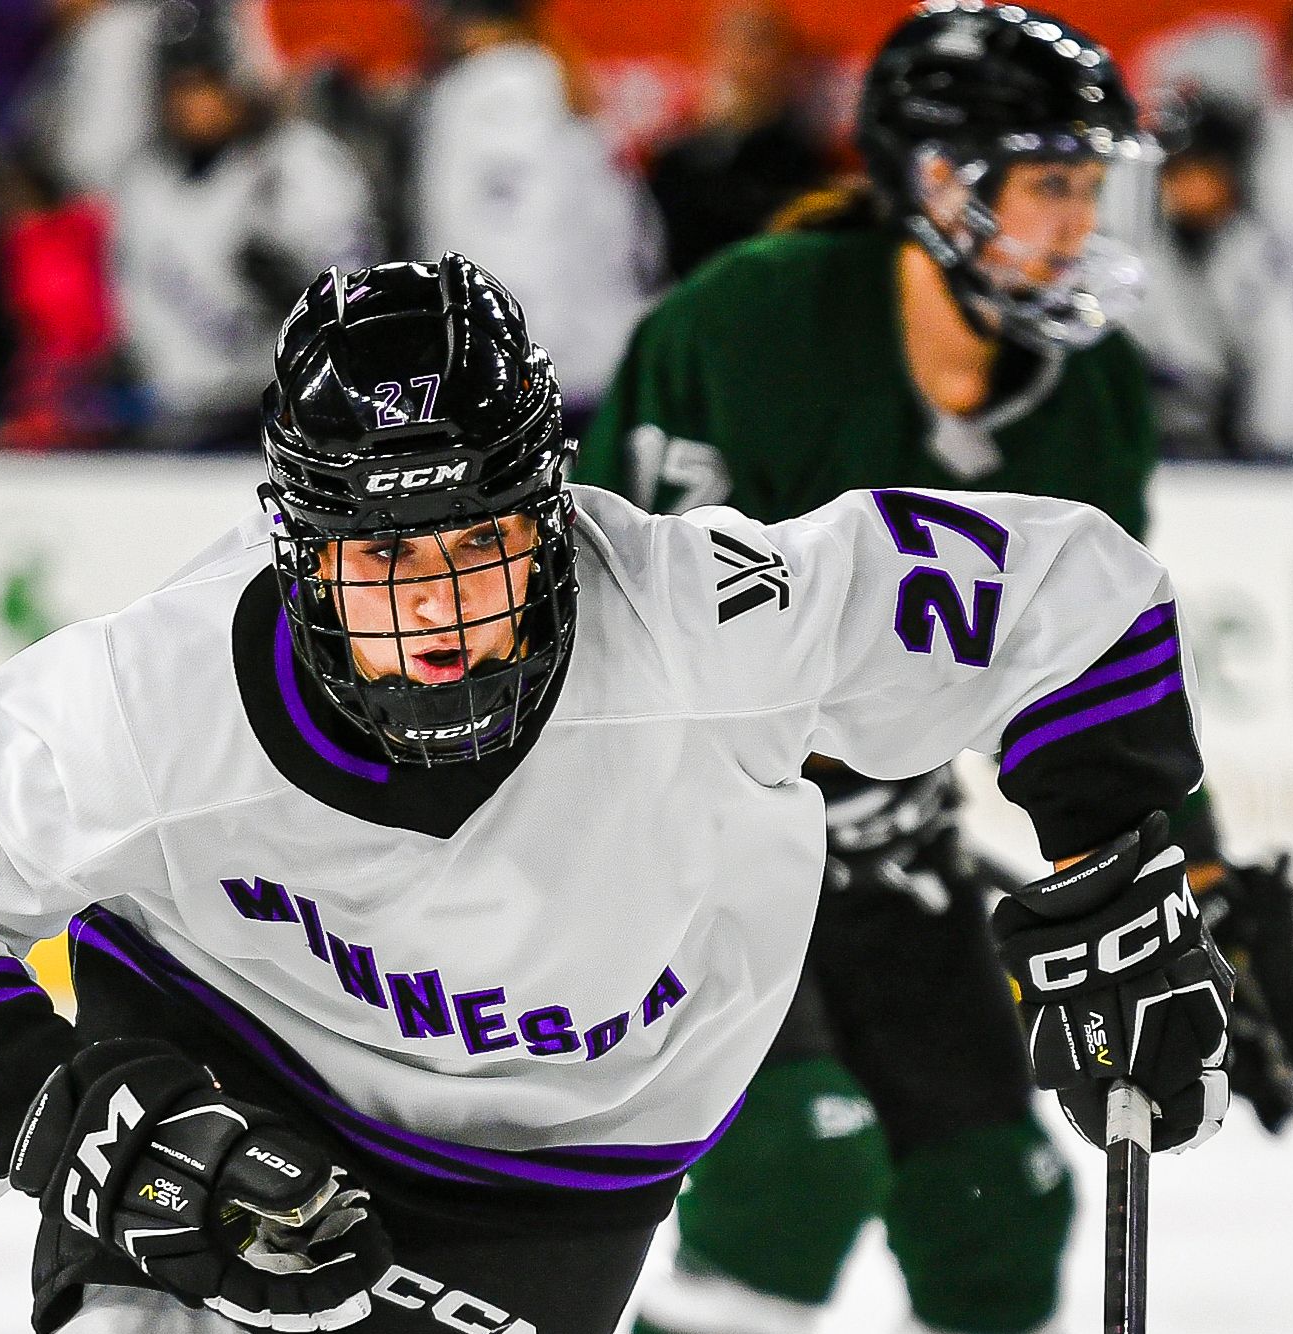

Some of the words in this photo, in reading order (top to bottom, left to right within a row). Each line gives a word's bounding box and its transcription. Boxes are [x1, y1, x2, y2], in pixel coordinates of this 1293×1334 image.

[373, 374, 442, 427] 27
[365, 461, 468, 493] CCM
[870, 489, 1009, 667] 27
[404, 714, 493, 740] CCM
[1029, 873, 1200, 991] CCM
[219, 876, 688, 1061] MINNESOA
[1083, 1024, 1096, 1055] PRO
[63, 1083, 146, 1238] CM
[245, 1146, 302, 1178] CCM
[154, 1178, 182, 1195] PRO
